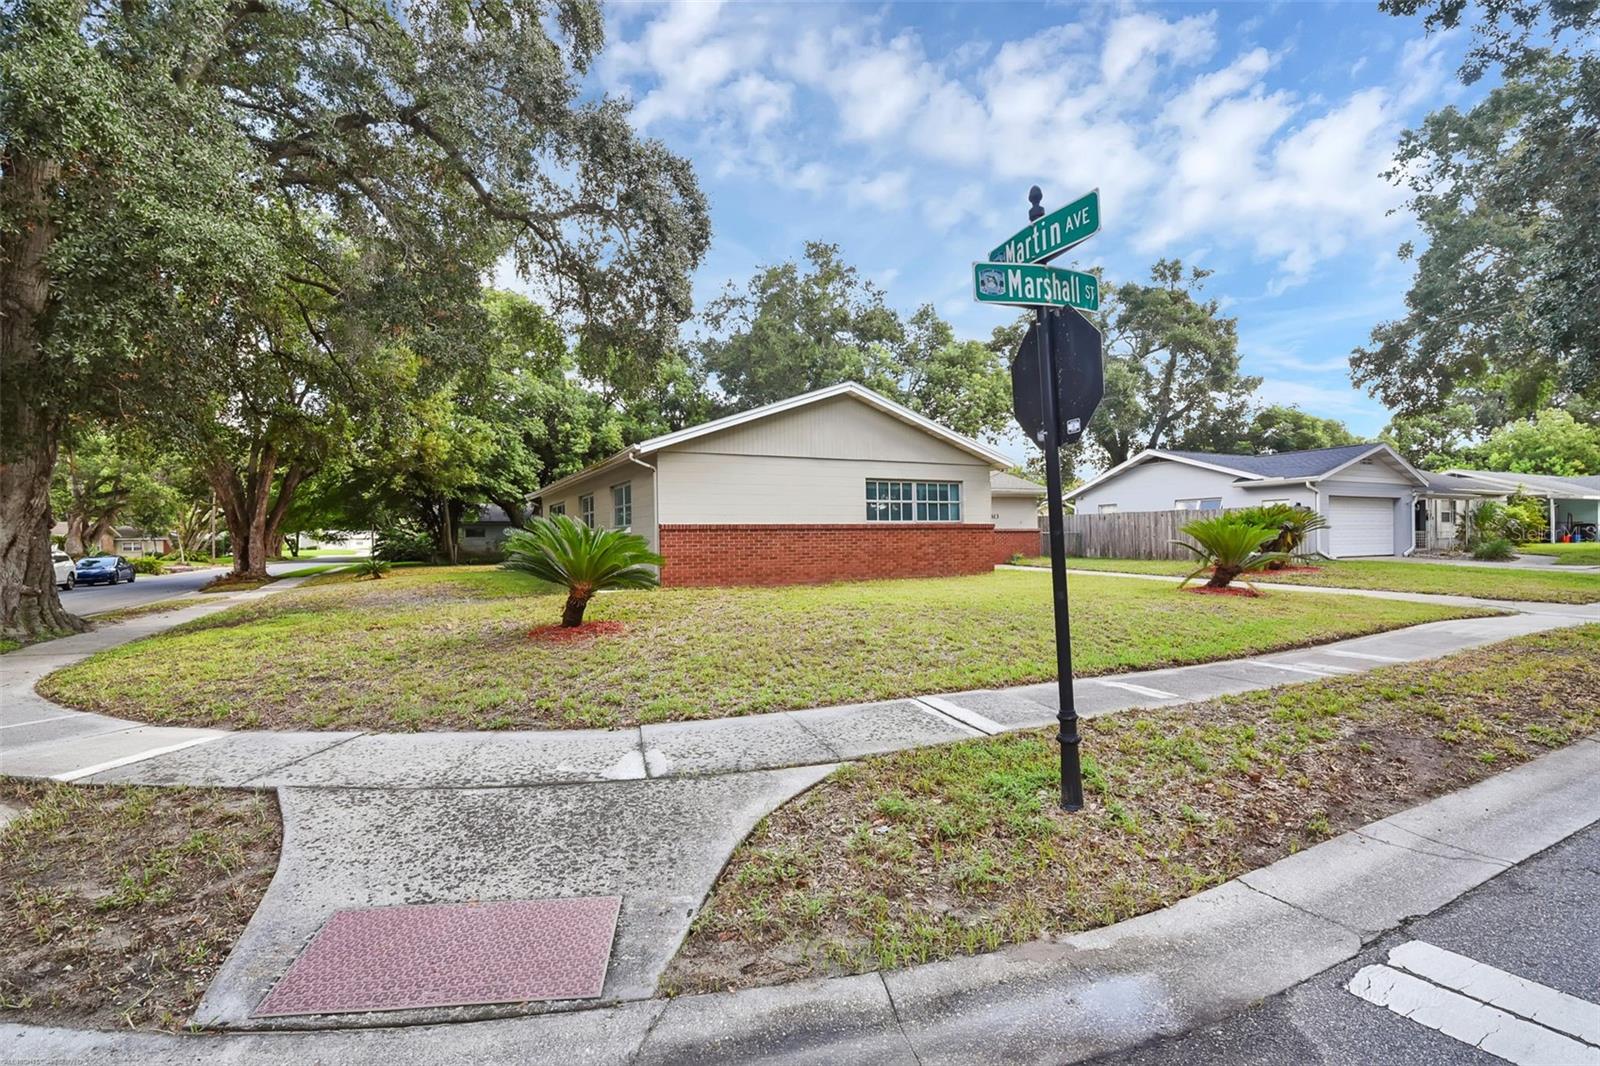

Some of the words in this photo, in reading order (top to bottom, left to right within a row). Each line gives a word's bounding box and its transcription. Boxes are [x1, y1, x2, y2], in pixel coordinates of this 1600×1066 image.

[1005, 222, 1061, 263] Martin
[1065, 207, 1090, 233] AVE
[1008, 269, 1080, 303] Marshall
[1085, 285, 1095, 301] ST
